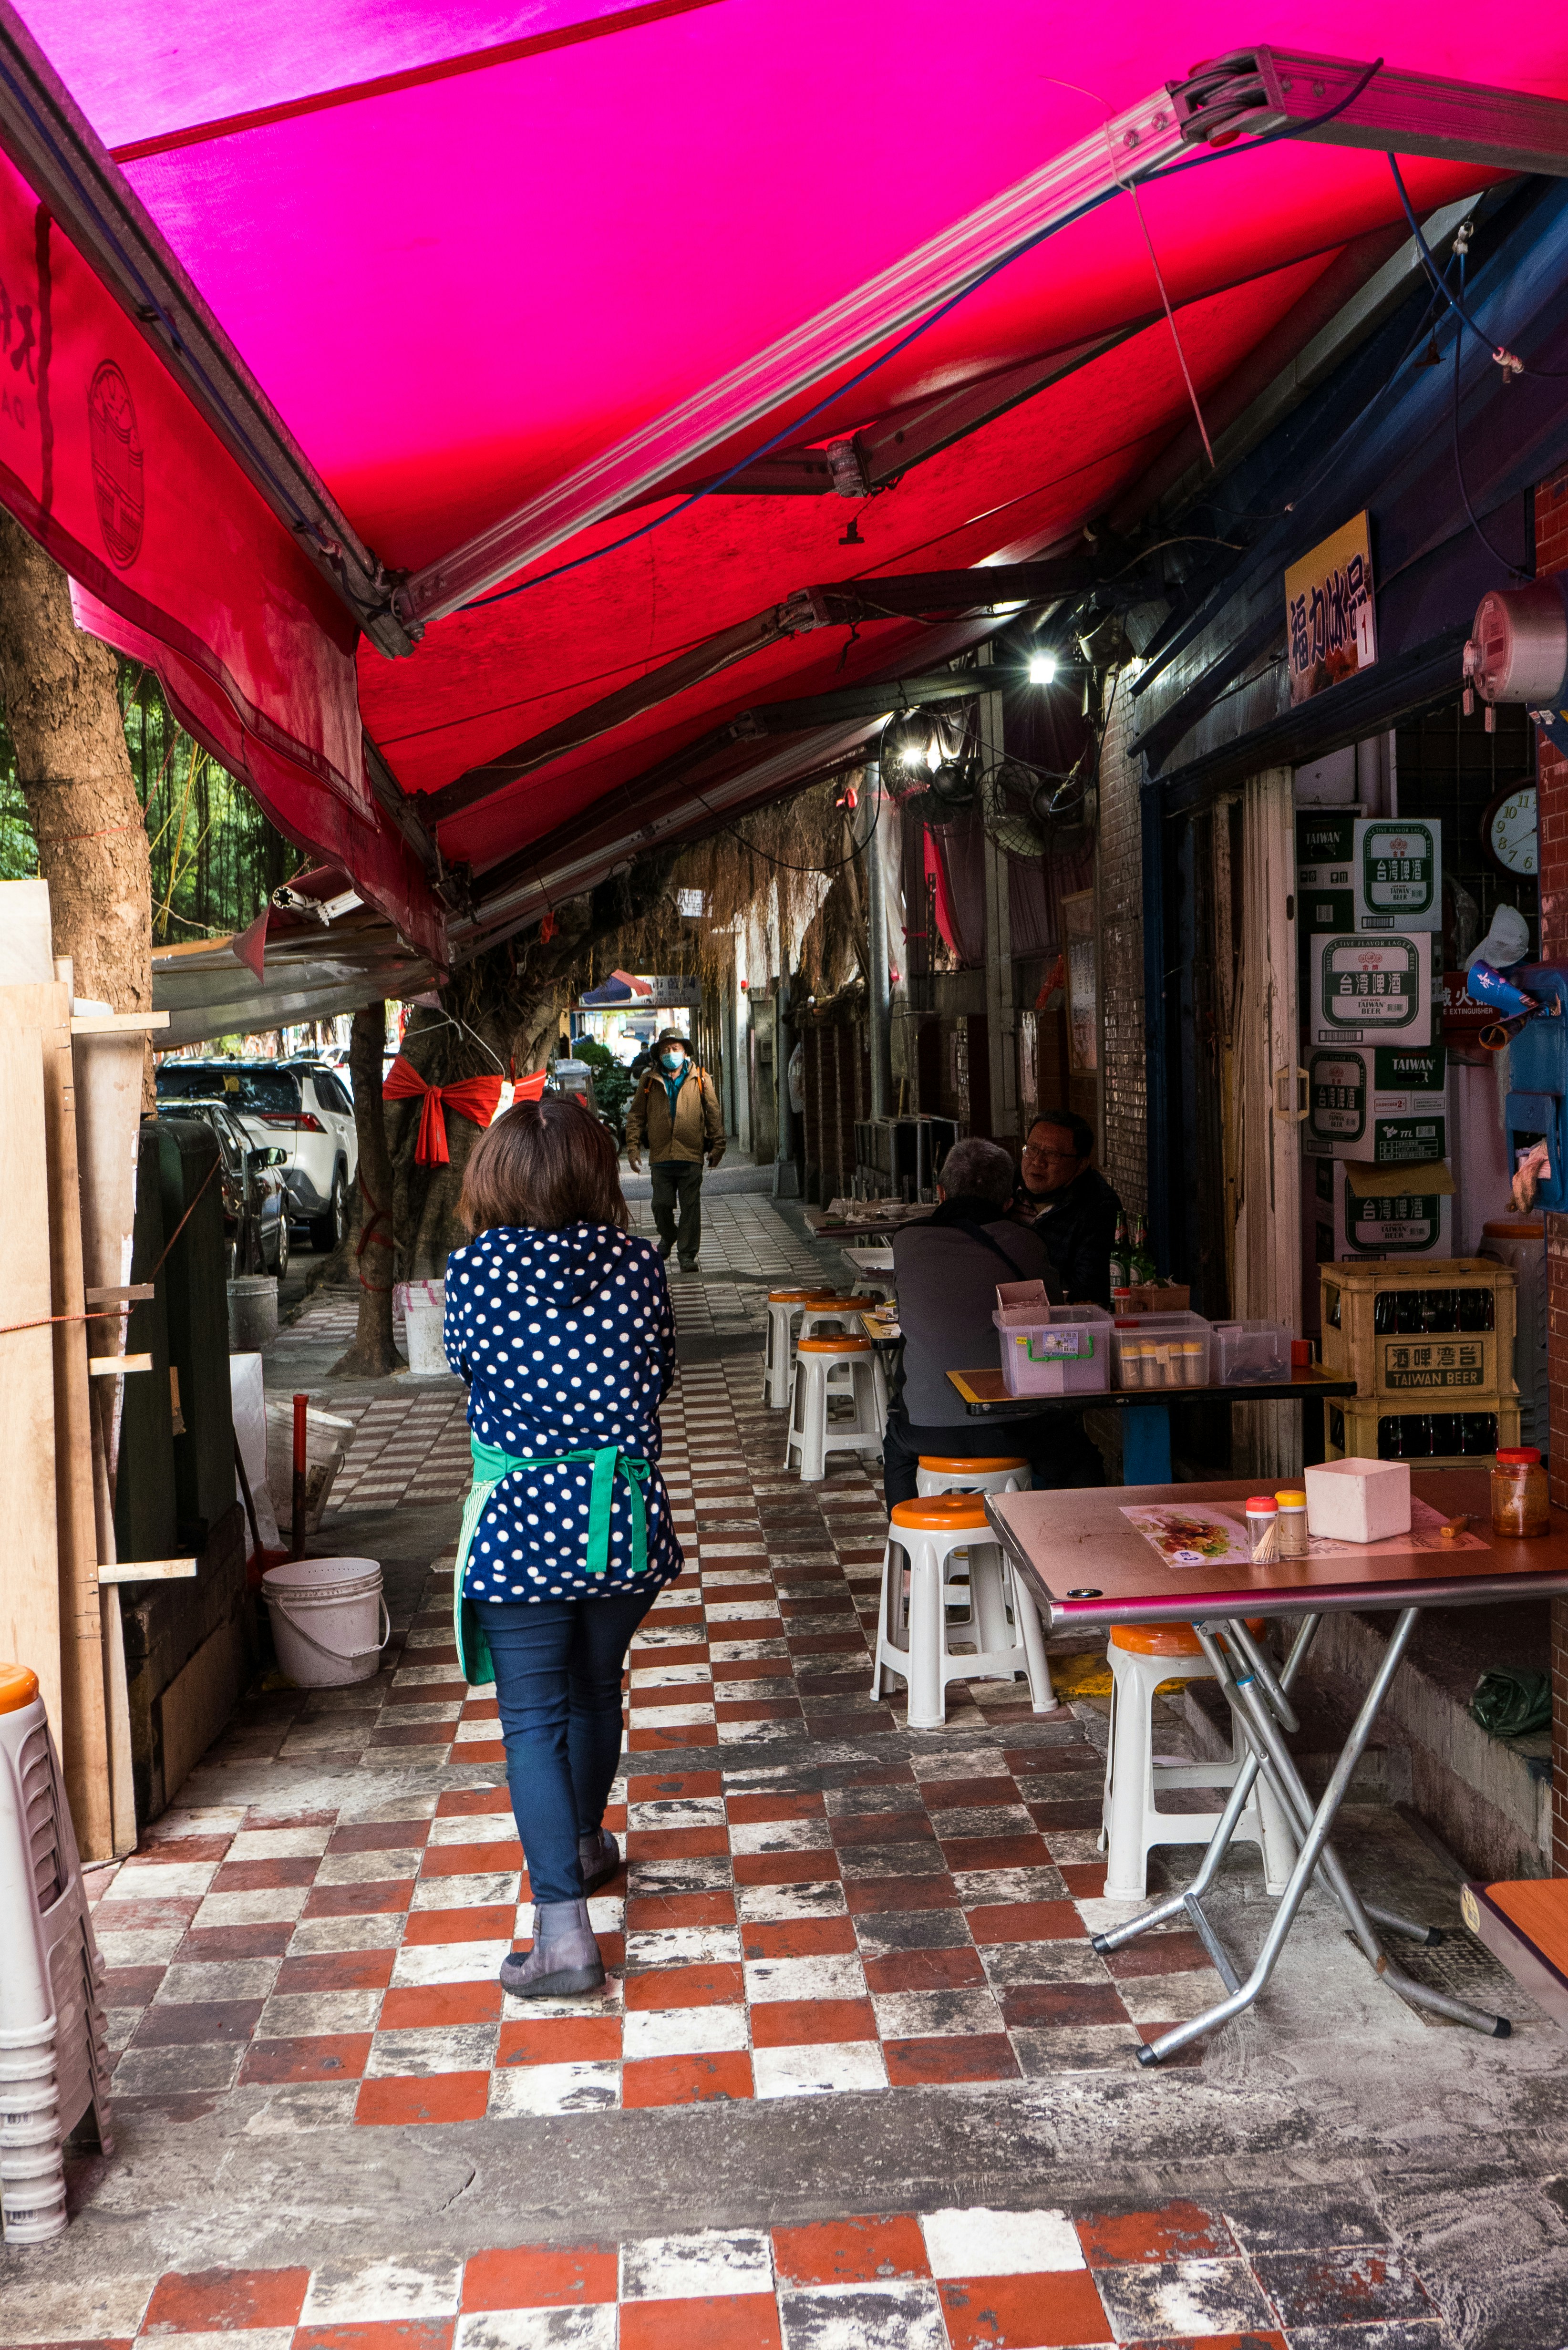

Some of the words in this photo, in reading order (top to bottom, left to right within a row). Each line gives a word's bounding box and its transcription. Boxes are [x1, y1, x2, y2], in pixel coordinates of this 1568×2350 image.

[1362, 614, 1368, 654] 1
[1517, 794, 1529, 808] 11
[1503, 806, 1517, 819] 10
[1496, 821, 1505, 833] 9
[1305, 832, 1341, 845] TAIWAN
[1497, 837, 1507, 849] 8
[1509, 850, 1518, 863] 7
[1523, 856, 1533, 868] 6
[1326, 941, 1354, 971] DISTINCTIVE
[1388, 941, 1412, 950] LAGER
[1392, 1059, 1433, 1070] TAIWAN
[1393, 1372, 1441, 1386] TAIWAN
[1447, 1371, 1477, 1384] BEER
